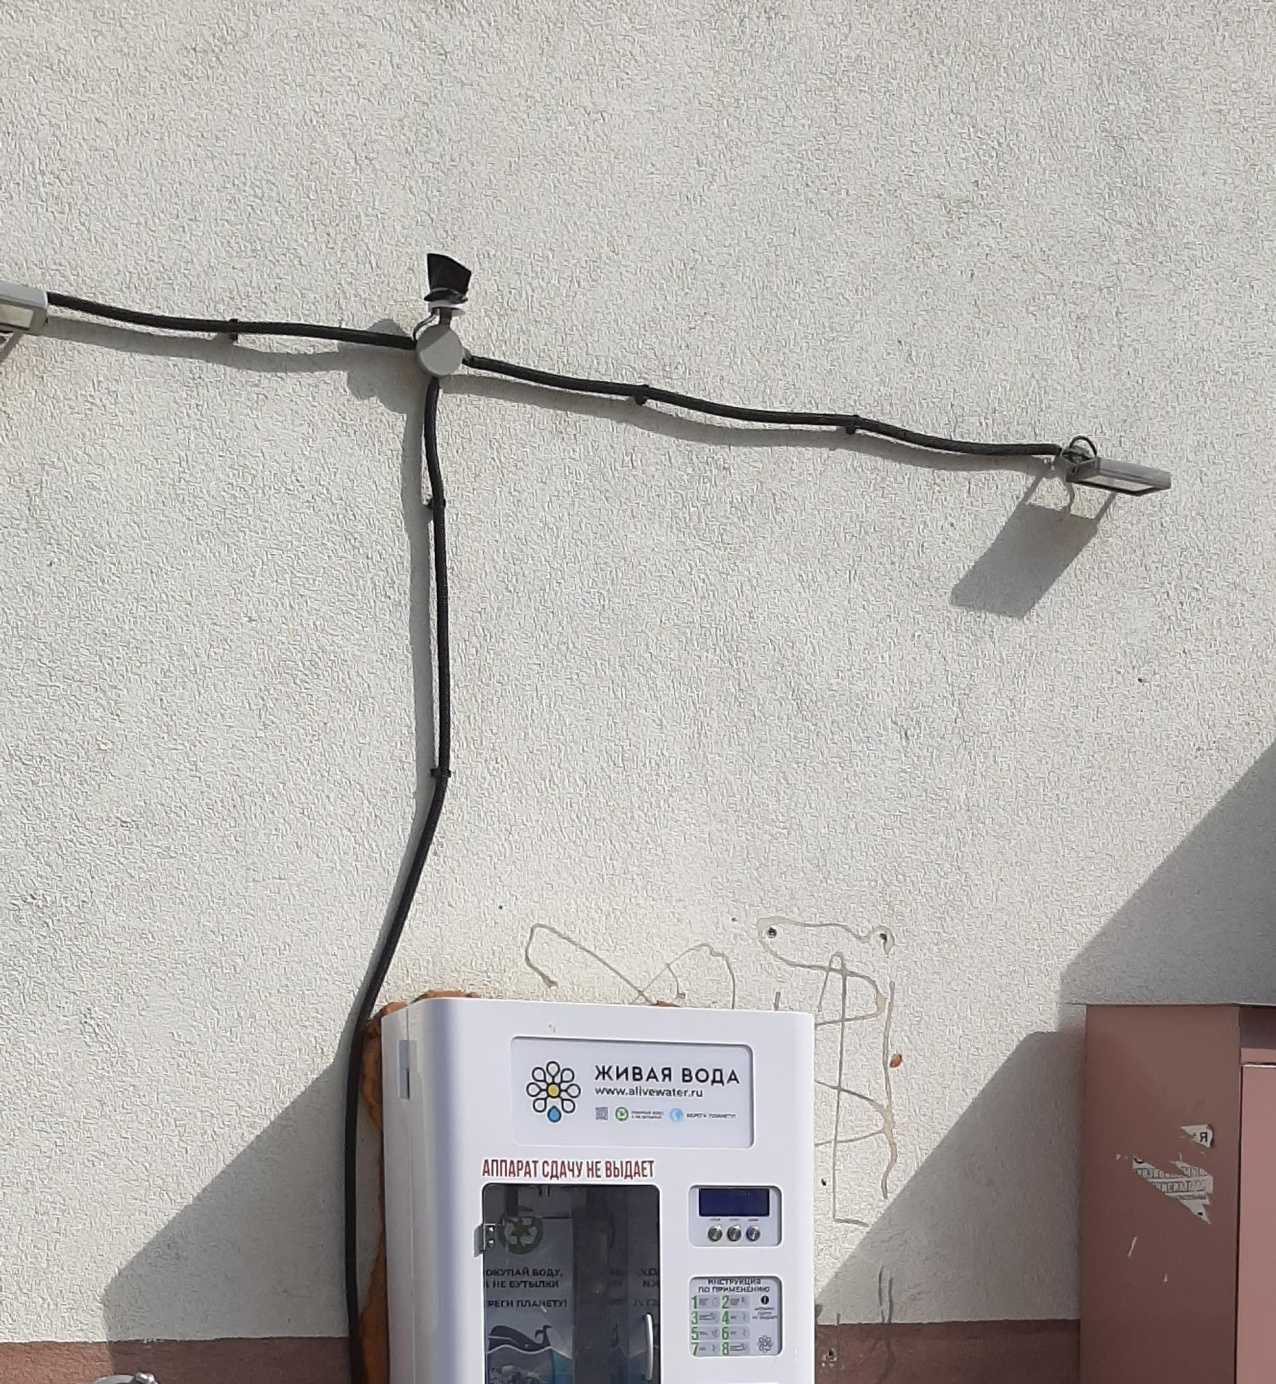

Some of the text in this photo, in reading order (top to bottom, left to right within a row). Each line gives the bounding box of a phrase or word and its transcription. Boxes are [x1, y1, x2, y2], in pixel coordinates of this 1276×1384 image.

[595, 1065, 740, 1086] ЖИВАЯ ВОДА
[595, 1086, 703, 1098] www.alivewater.ru
[482, 1159, 655, 1180] АППАРАТ СДАЧУ НЕ ВЫДАЕТ
[486, 1266, 530, 1277] ОКУПАЙ
[691, 1295, 699, 1309] 1
[721, 1295, 729, 1309] 2
[691, 1310, 699, 1325] 3
[721, 1310, 729, 1325] 4
[691, 1326, 699, 1341] 5
[721, 1326, 729, 1341] 6
[691, 1342, 699, 1356] 7
[721, 1342, 729, 1356] 8
